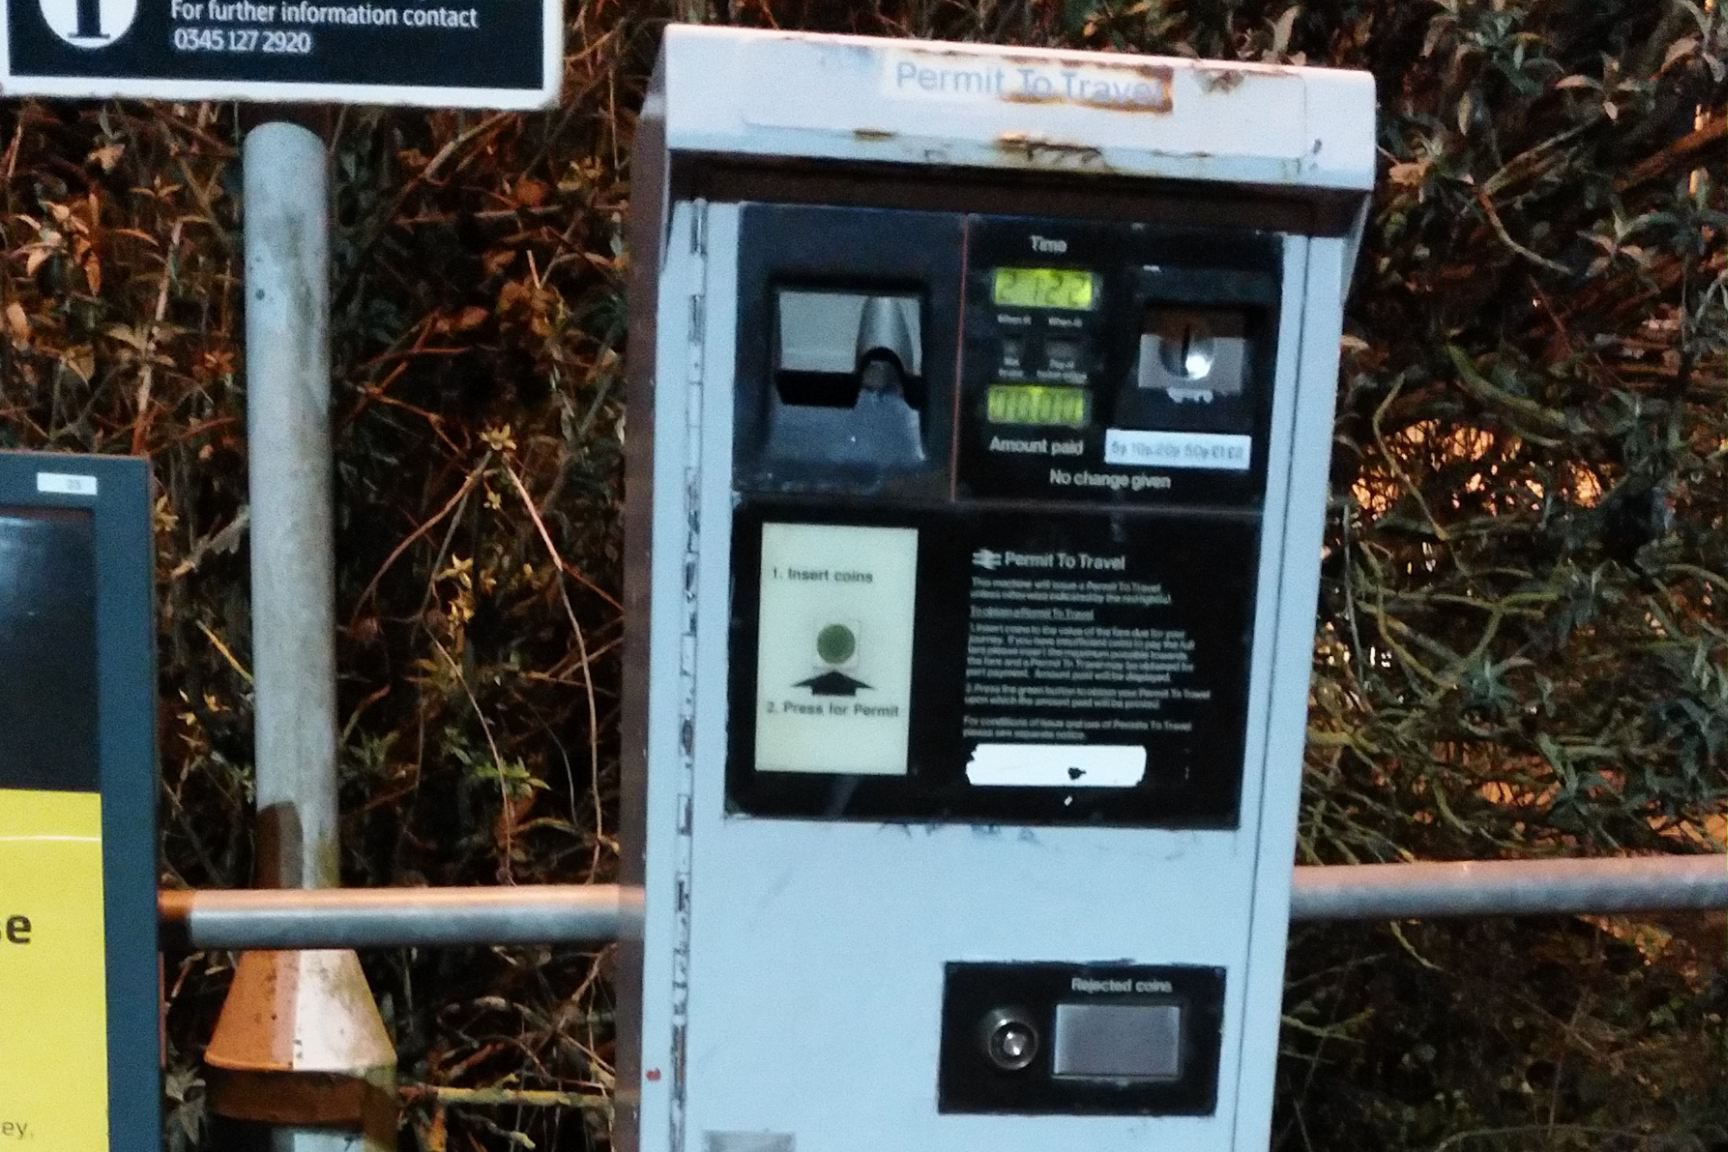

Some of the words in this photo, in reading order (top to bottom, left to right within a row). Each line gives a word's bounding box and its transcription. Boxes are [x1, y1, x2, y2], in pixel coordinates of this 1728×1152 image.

[171, 0, 201, 20] For
[208, 0, 275, 21] further
[281, 0, 398, 25] information
[402, 8, 478, 28] contact
[174, 27, 224, 50] 0345
[228, 30, 258, 51] 127
[262, 31, 311, 53] 2920
[896, 60, 1004, 91] Permit
[1017, 68, 1053, 98] To
[1060, 70, 1163, 103] Travel
[1029, 234, 1068, 253] Time
[989, 435, 1048, 454] Amount
[1050, 439, 1084, 457] paid
[1050, 469, 1072, 485] No
[1074, 471, 1130, 491] change
[1131, 473, 1172, 491] given
[1005, 550, 1054, 567] Permit
[1058, 551, 1075, 568] To
[1078, 553, 1126, 571] Travel
[788, 567, 829, 582] Insert
[833, 568, 874, 584] coins
[783, 702, 824, 716] Press
[829, 702, 847, 716] for
[854, 703, 900, 718] Permit
[1071, 976, 1132, 994] Rejected
[1135, 979, 1174, 994] coins
